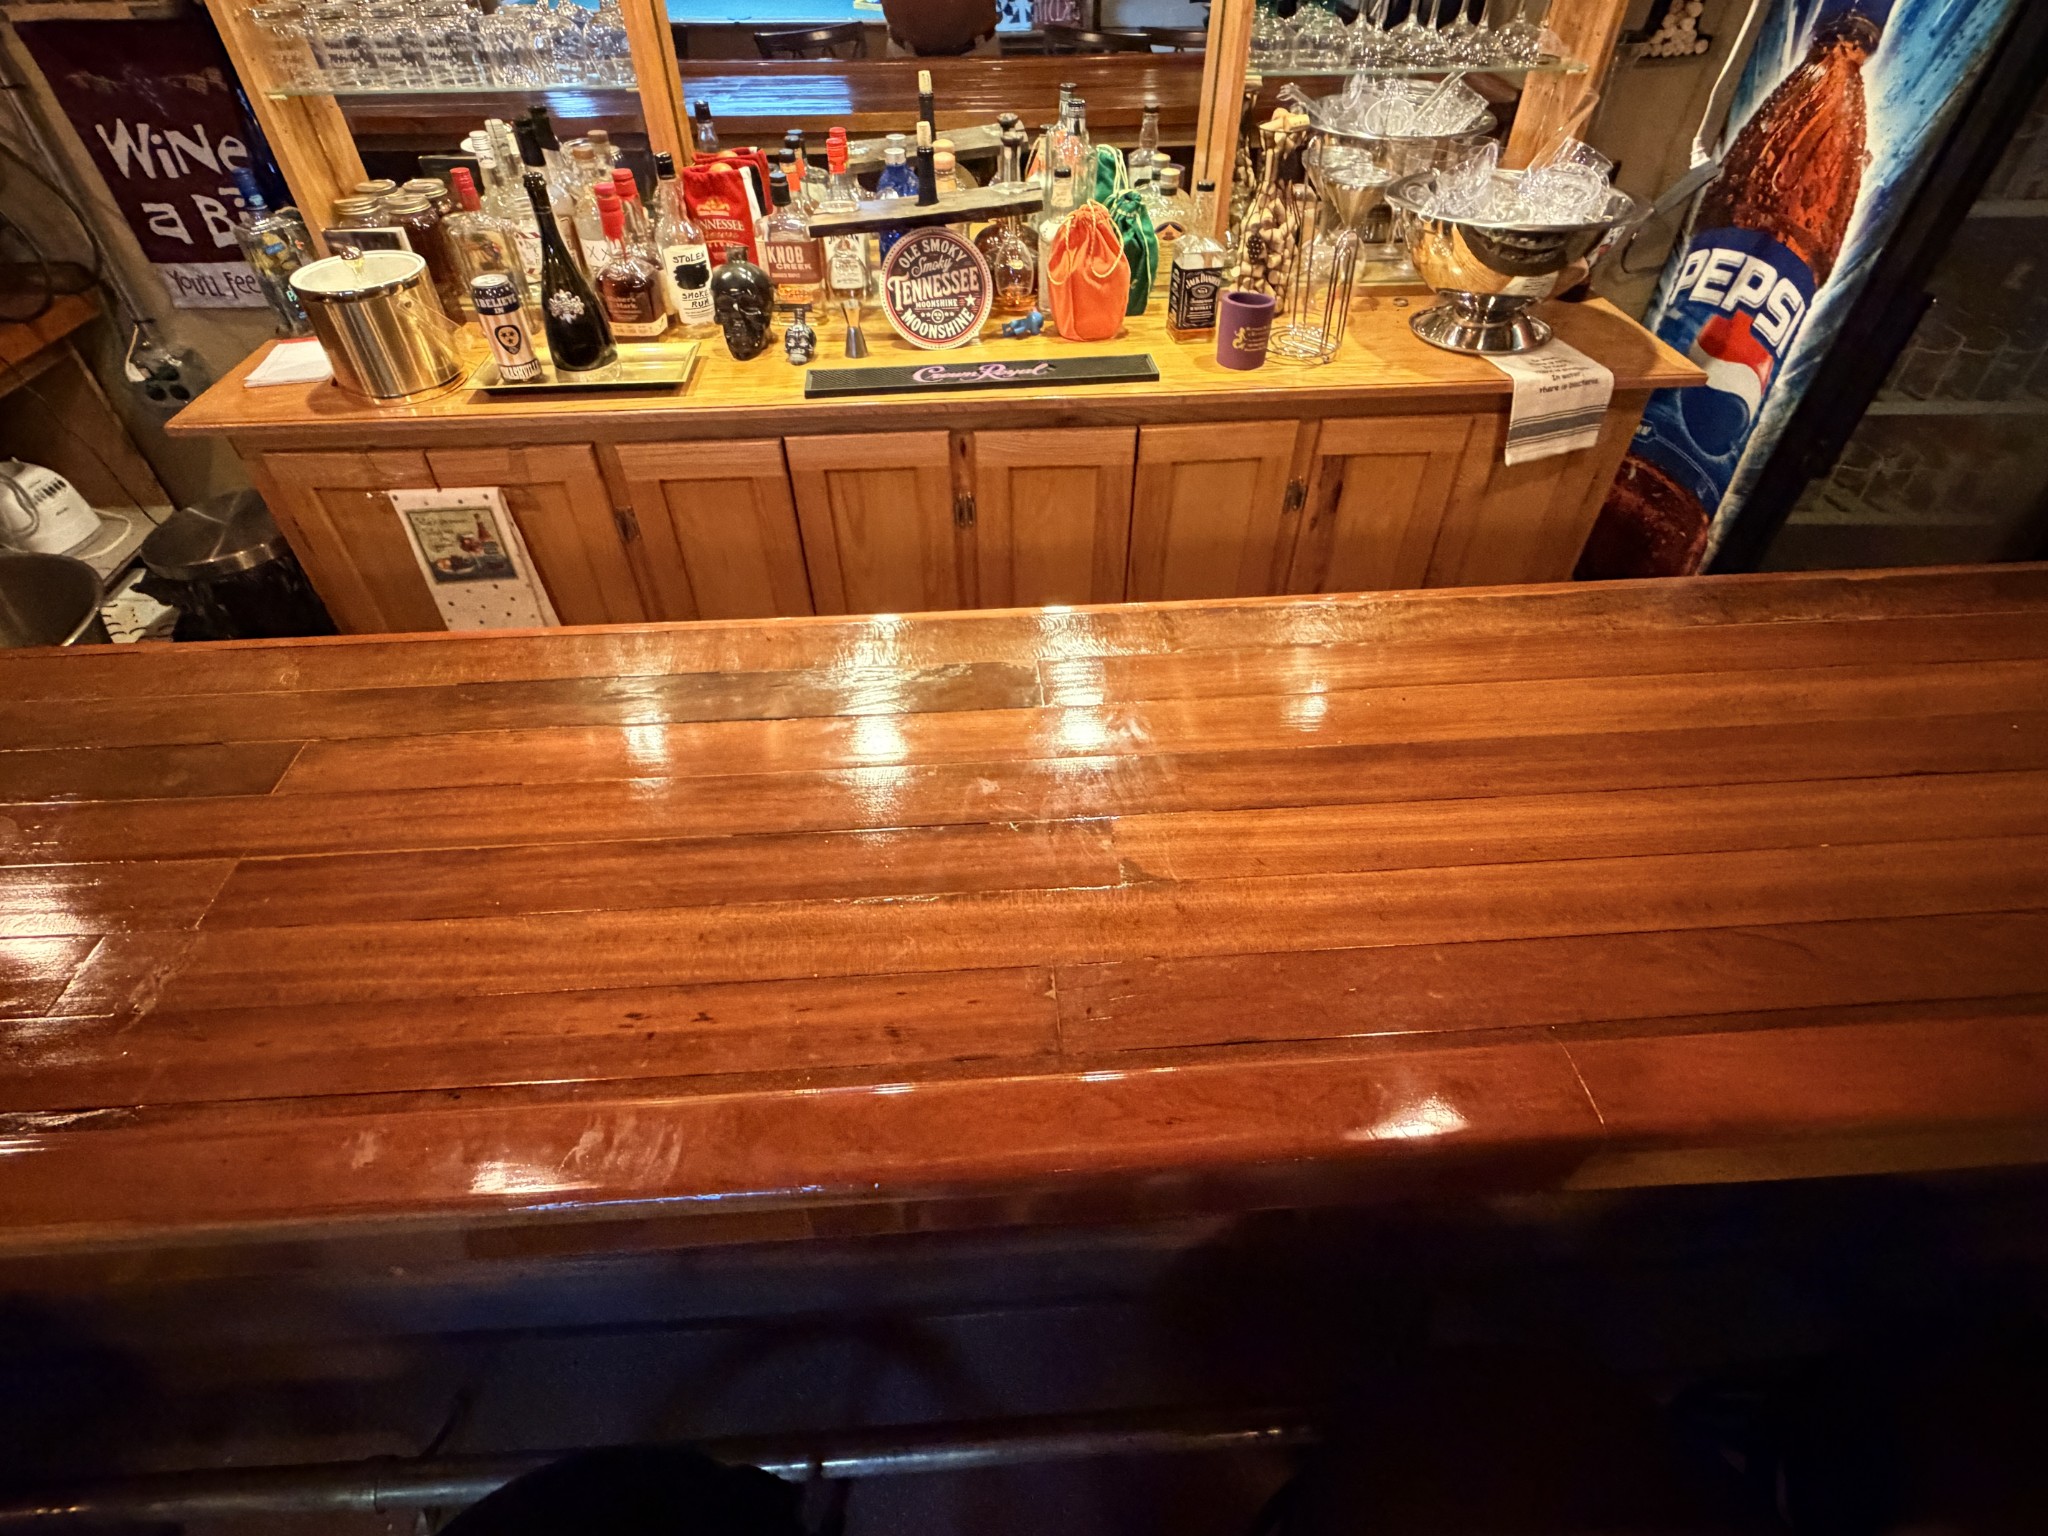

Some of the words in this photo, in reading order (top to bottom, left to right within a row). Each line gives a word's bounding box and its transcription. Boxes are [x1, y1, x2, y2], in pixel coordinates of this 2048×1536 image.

[767, 245, 804, 264] KNOB
[899, 245, 921, 268] OLE
[922, 238, 967, 262] SMOKY
[911, 255, 954, 277] Smoky
[887, 267, 980, 311] TENNESSEE
[691, 299, 710, 308] RUM
[915, 298, 959, 308] MOONSHINE
[901, 307, 975, 339] MOONSHINE
[960, 362, 1049, 381] Royal
